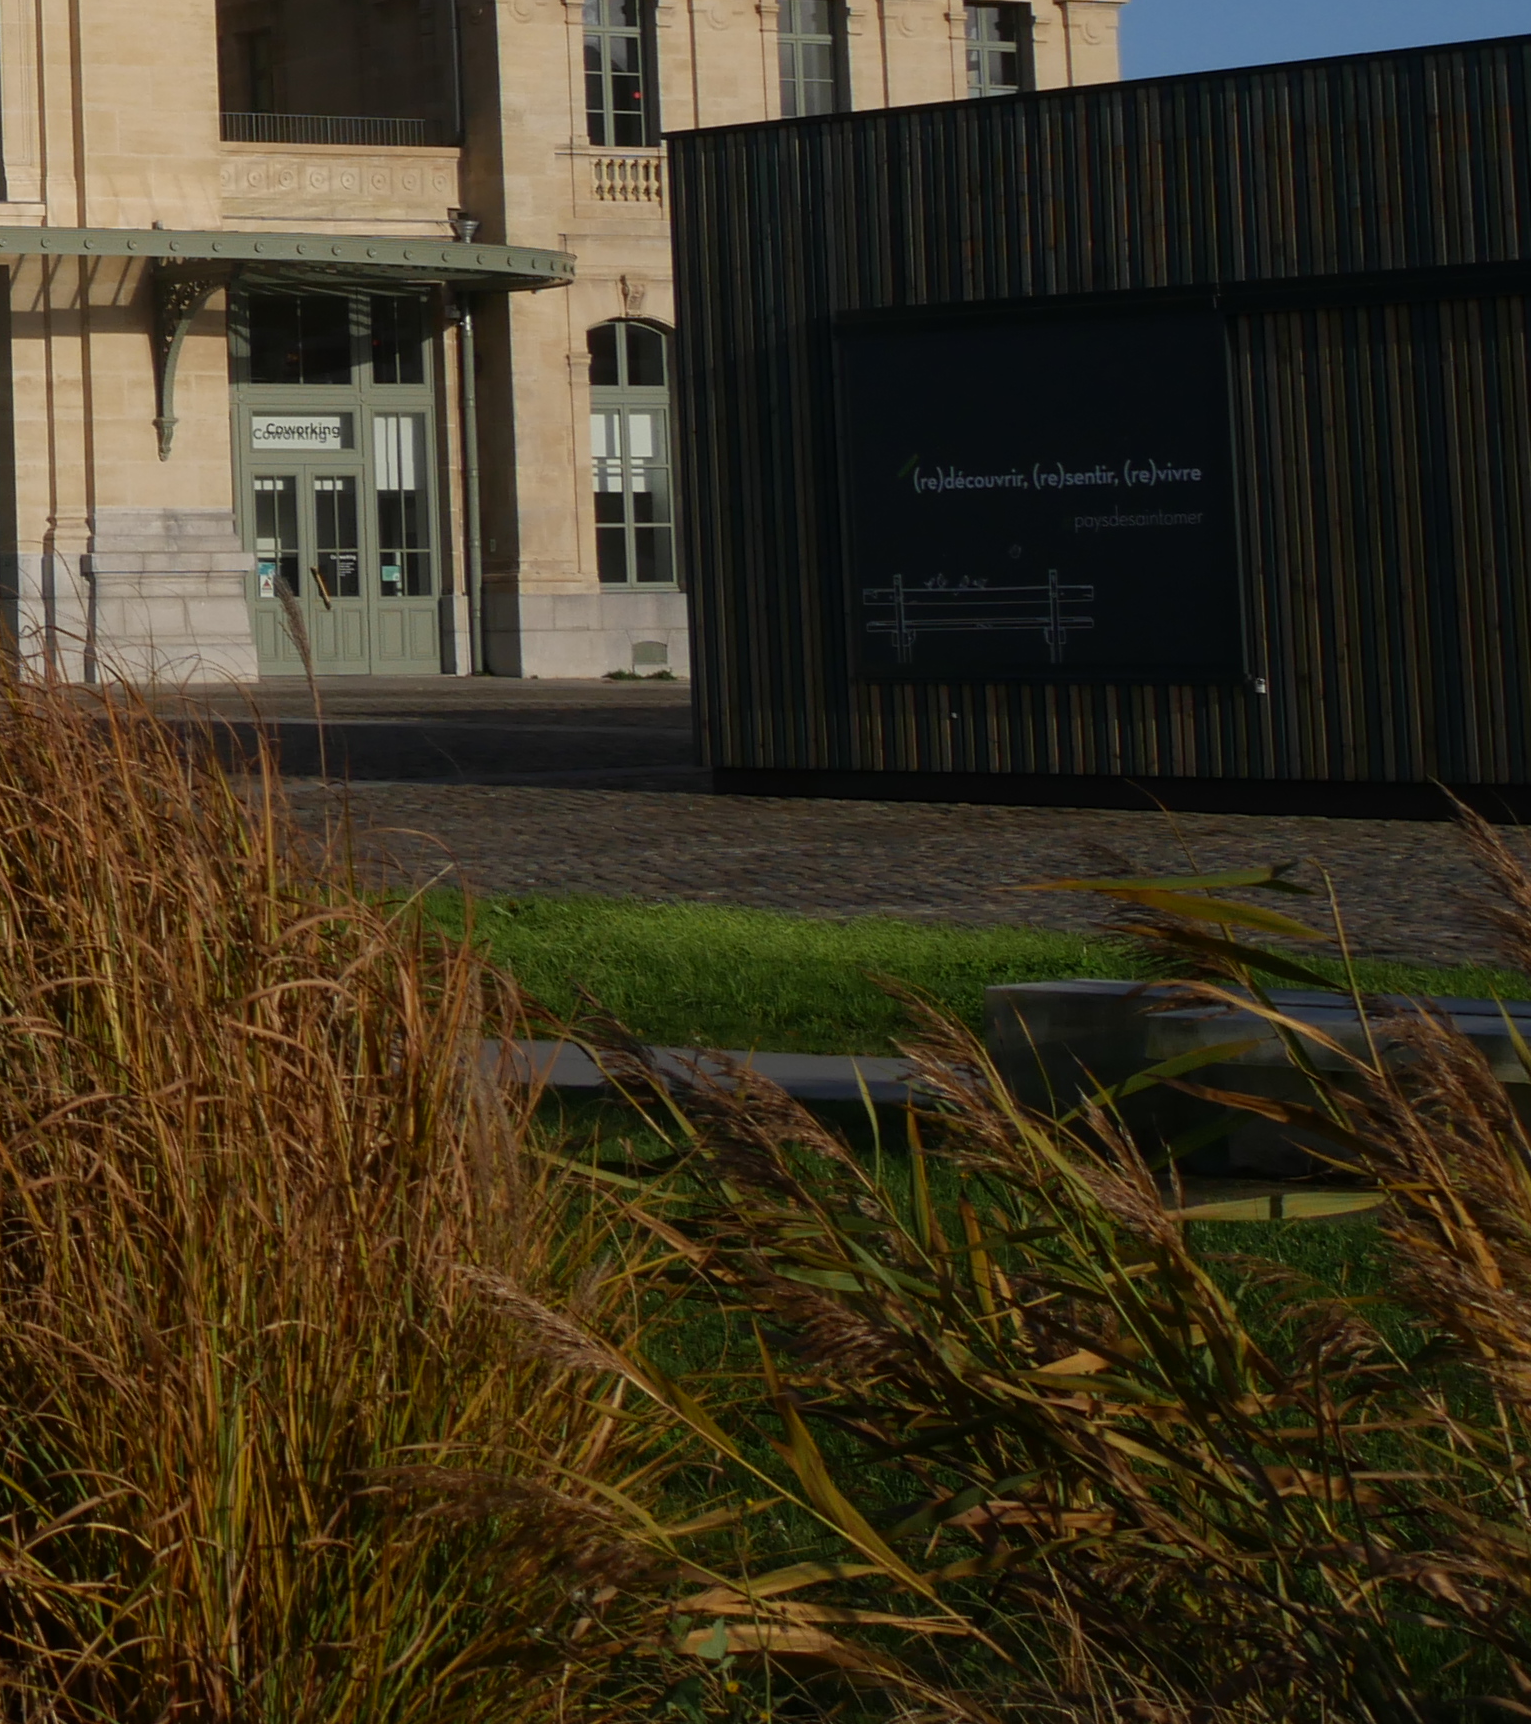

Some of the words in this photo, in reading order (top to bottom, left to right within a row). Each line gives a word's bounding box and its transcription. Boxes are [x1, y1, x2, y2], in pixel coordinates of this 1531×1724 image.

[266, 422, 341, 439] Coworking
[914, 465, 1029, 493] (re)découvrir,
[1033, 461, 1119, 490] (re)sentir,
[1124, 458, 1203, 487] (re)vivre
[1074, 505, 1204, 534] paysdesaintomer
